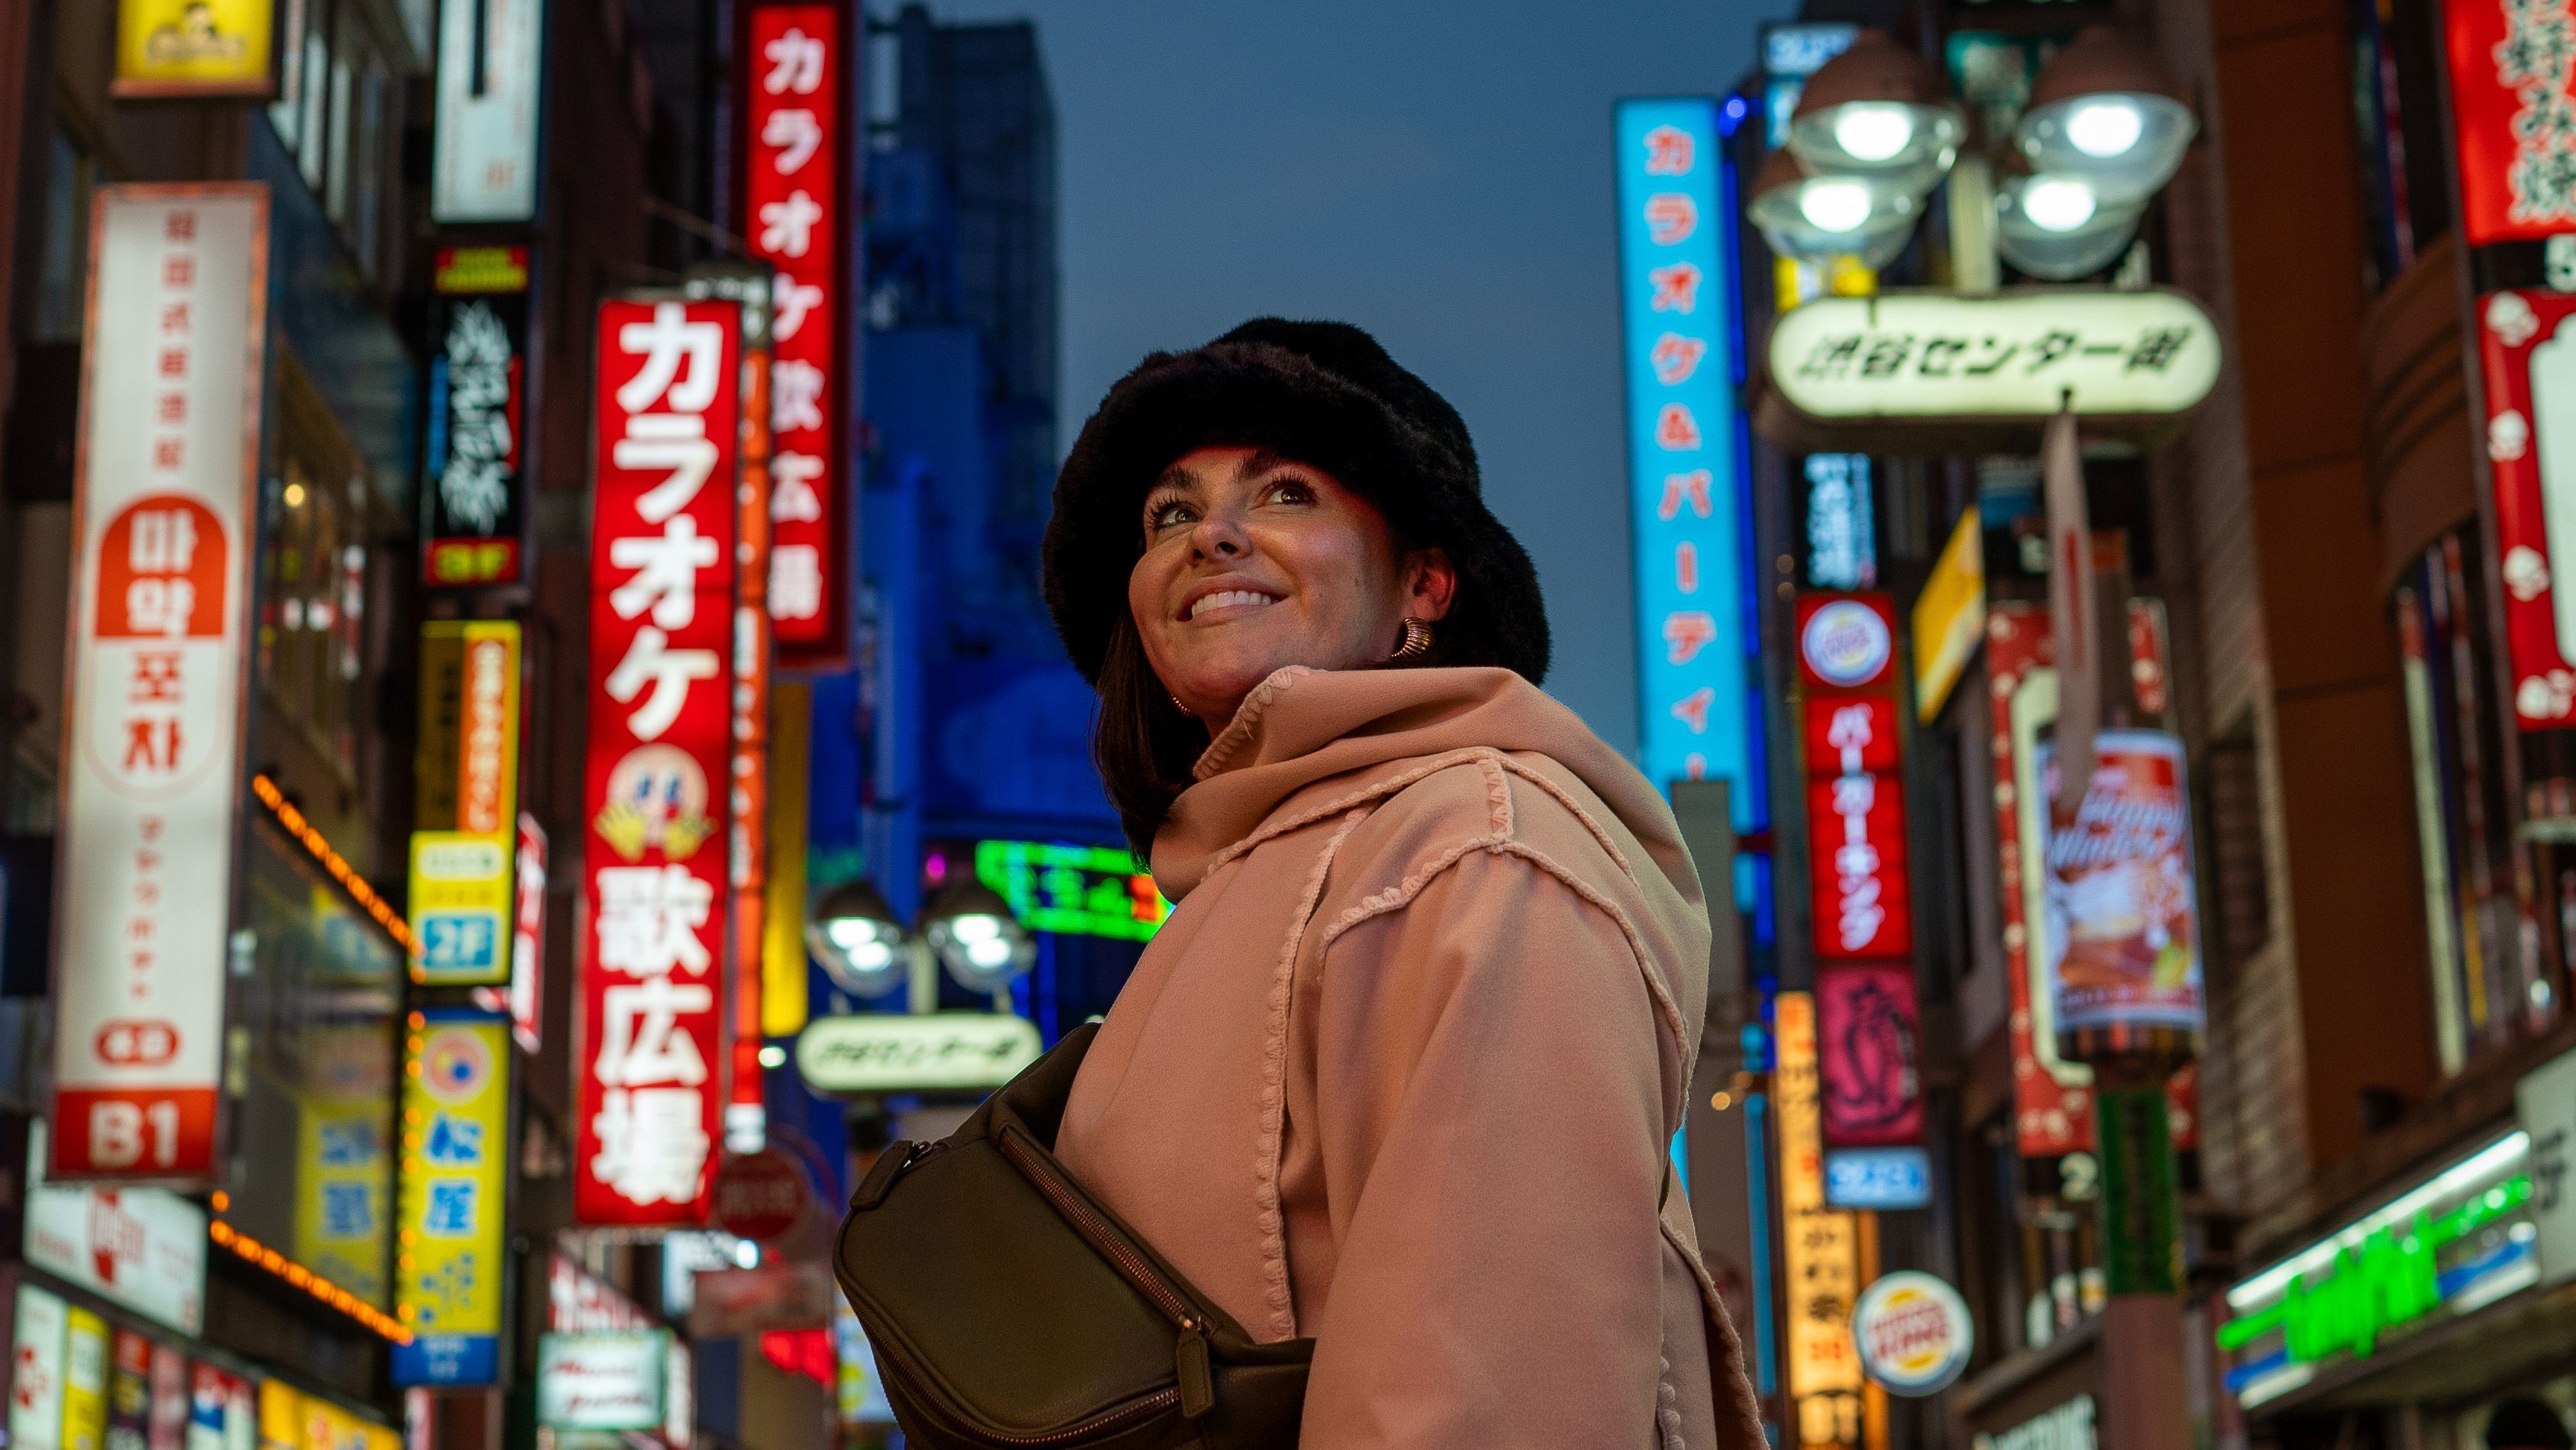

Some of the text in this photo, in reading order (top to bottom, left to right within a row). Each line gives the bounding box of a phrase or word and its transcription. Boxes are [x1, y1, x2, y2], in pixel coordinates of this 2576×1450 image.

[1796, 321, 2193, 379] 渋谷センター街
[606, 302, 723, 743] カラオケ
[429, 919, 489, 964] 2F
[591, 862, 713, 1207] 歌広場
[88, 1100, 180, 1169] B1
